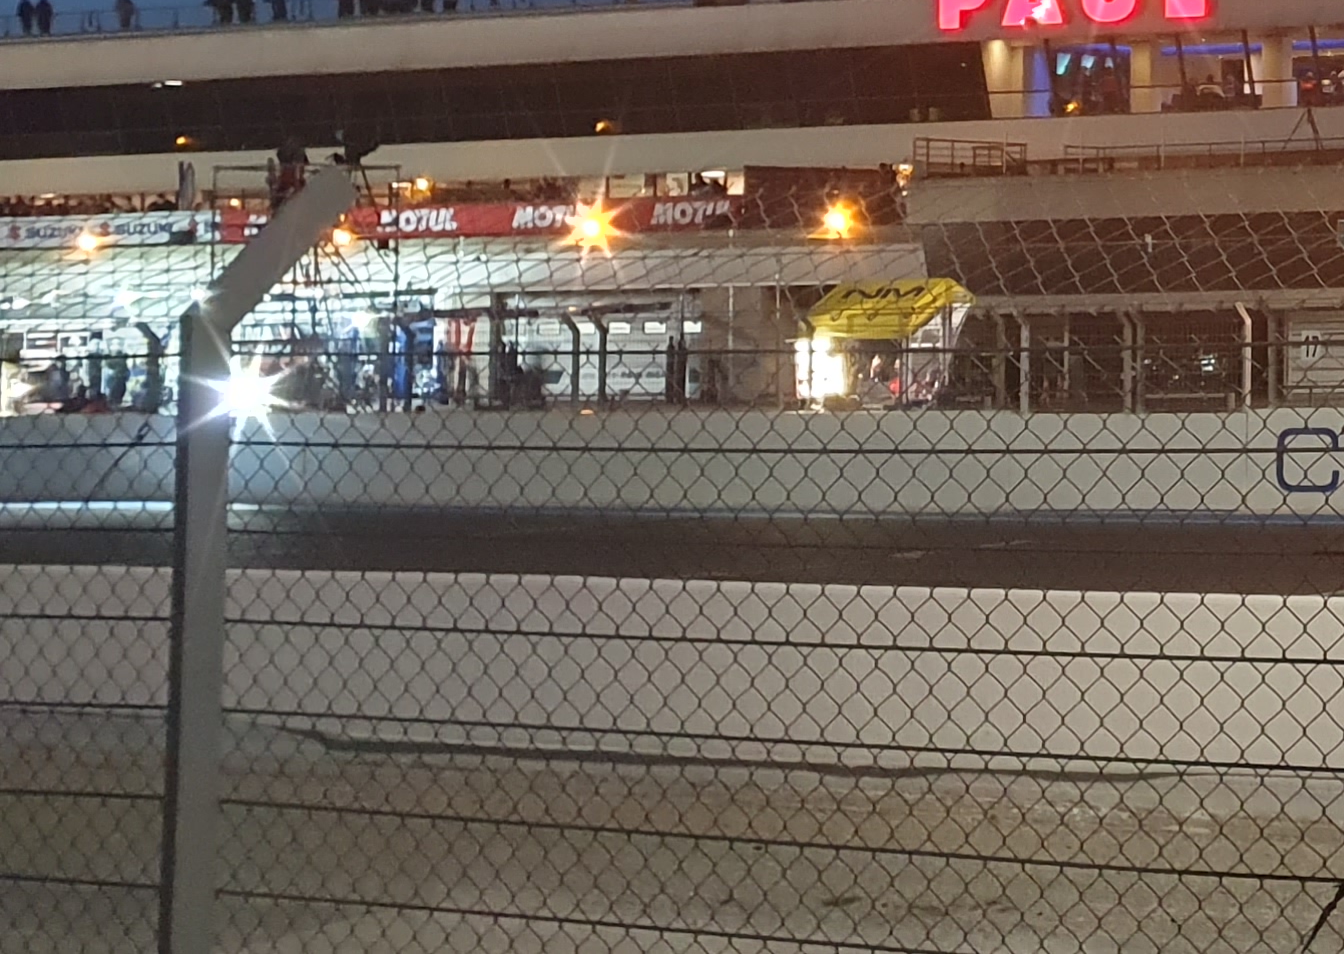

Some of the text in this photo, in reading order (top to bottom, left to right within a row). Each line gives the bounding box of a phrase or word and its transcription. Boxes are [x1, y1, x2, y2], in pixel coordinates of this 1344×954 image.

[113, 220, 173, 236] SUZUKI
[376, 207, 458, 233] MOTUL
[511, 204, 581, 229] MOTU
[1304, 335, 1320, 359] 17
